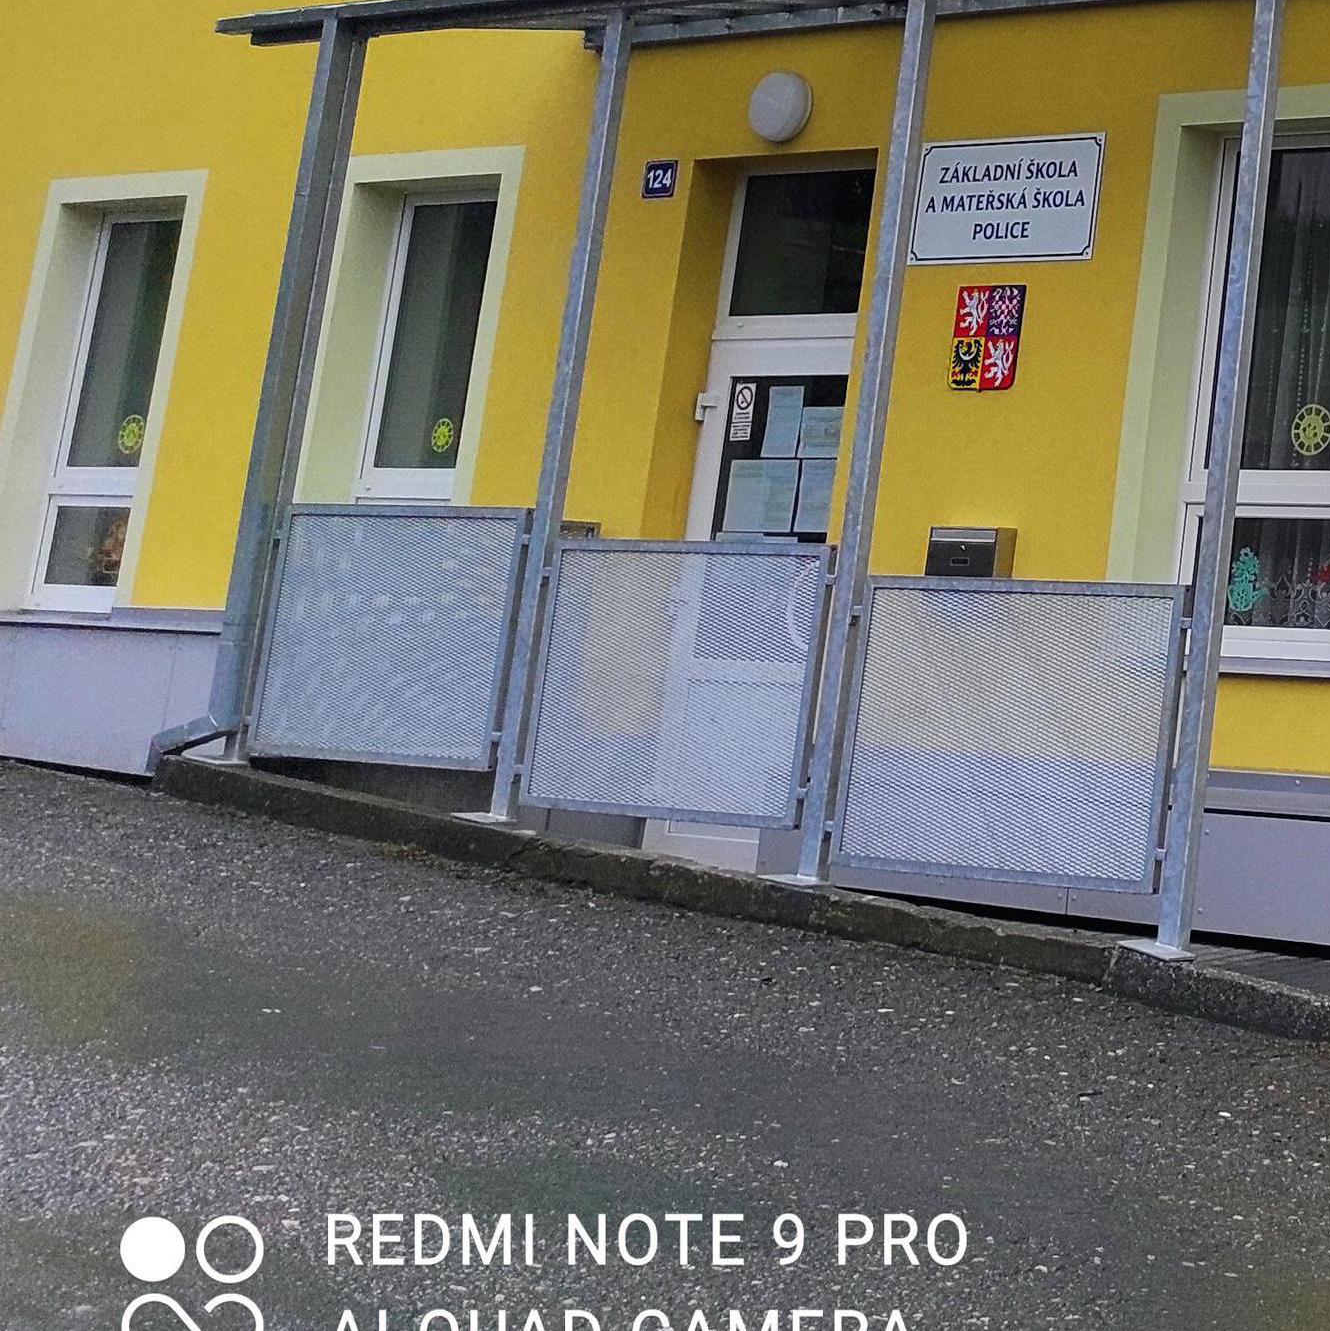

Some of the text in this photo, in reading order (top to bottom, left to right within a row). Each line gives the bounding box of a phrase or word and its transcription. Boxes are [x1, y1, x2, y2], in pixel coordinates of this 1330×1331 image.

[647, 168, 672, 189] 124
[939, 158, 1079, 184] ZÁKLADNÍ ŠKOLA
[925, 187, 1085, 213] A MATEŘSKÁ ŠKOLA
[972, 221, 1030, 240] POLICE
